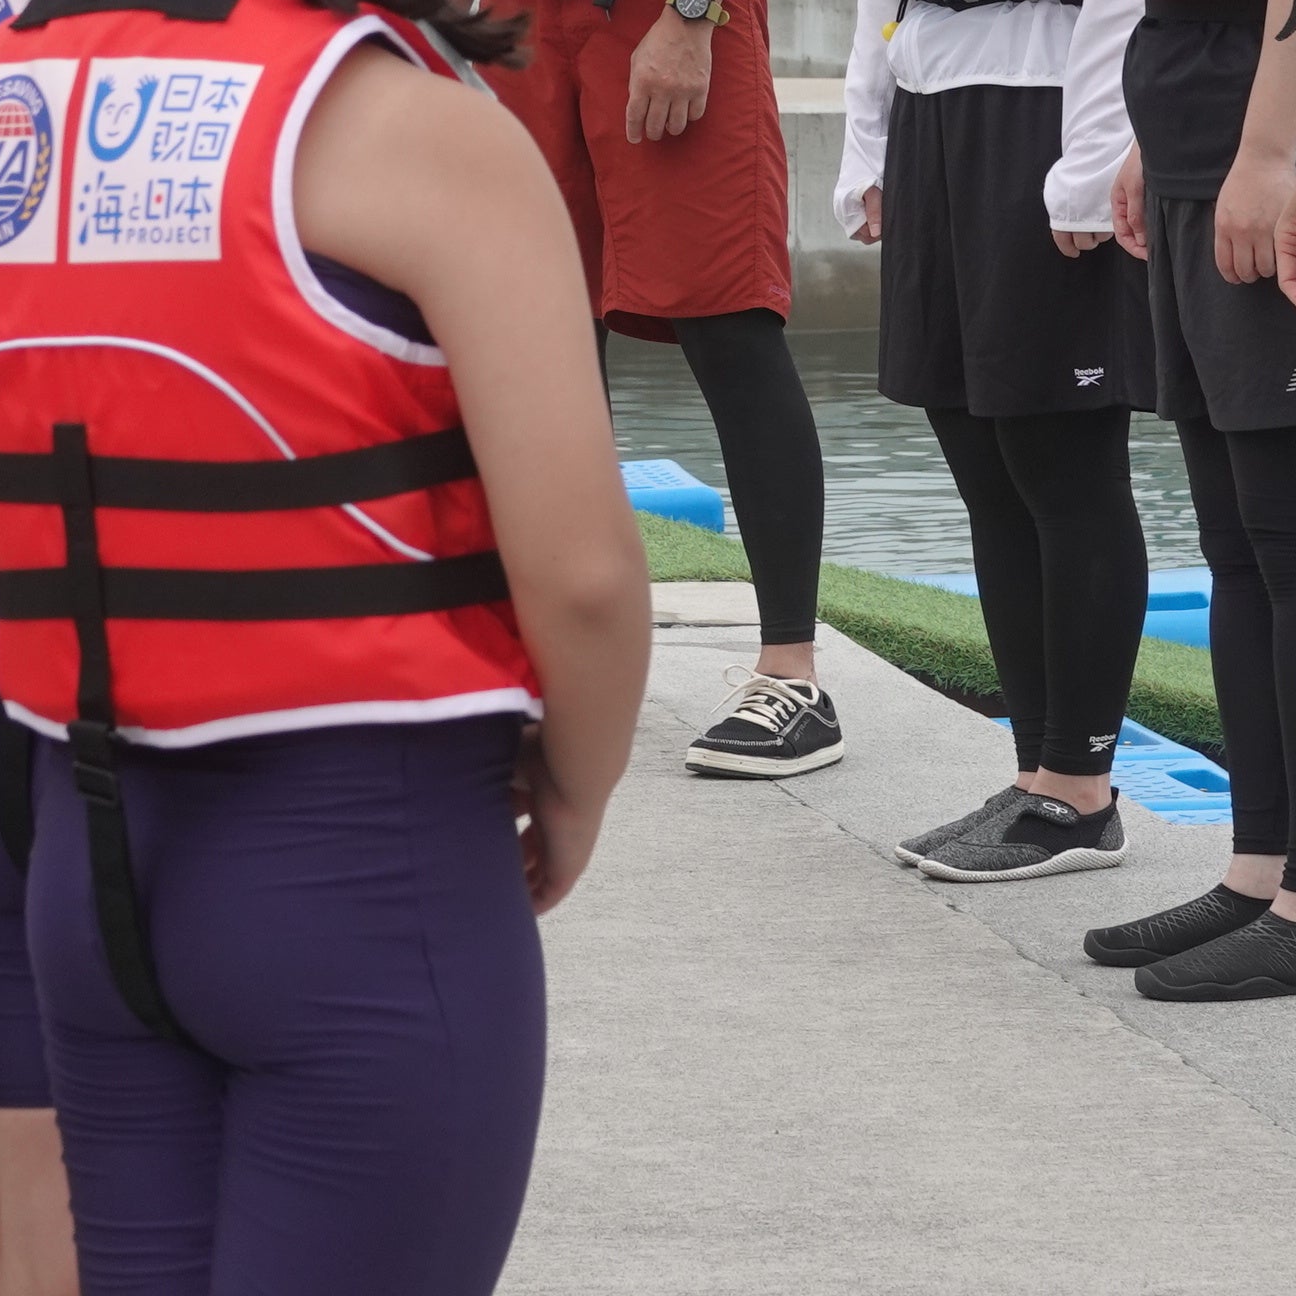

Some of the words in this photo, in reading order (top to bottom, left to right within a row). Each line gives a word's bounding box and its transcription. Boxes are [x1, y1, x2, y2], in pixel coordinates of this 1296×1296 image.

[160, 74, 247, 112] 日本
[126, 226, 212, 244] PROJECT
[1074, 367, 1104, 376] Reebok
[1089, 733, 1118, 743] Reebok
